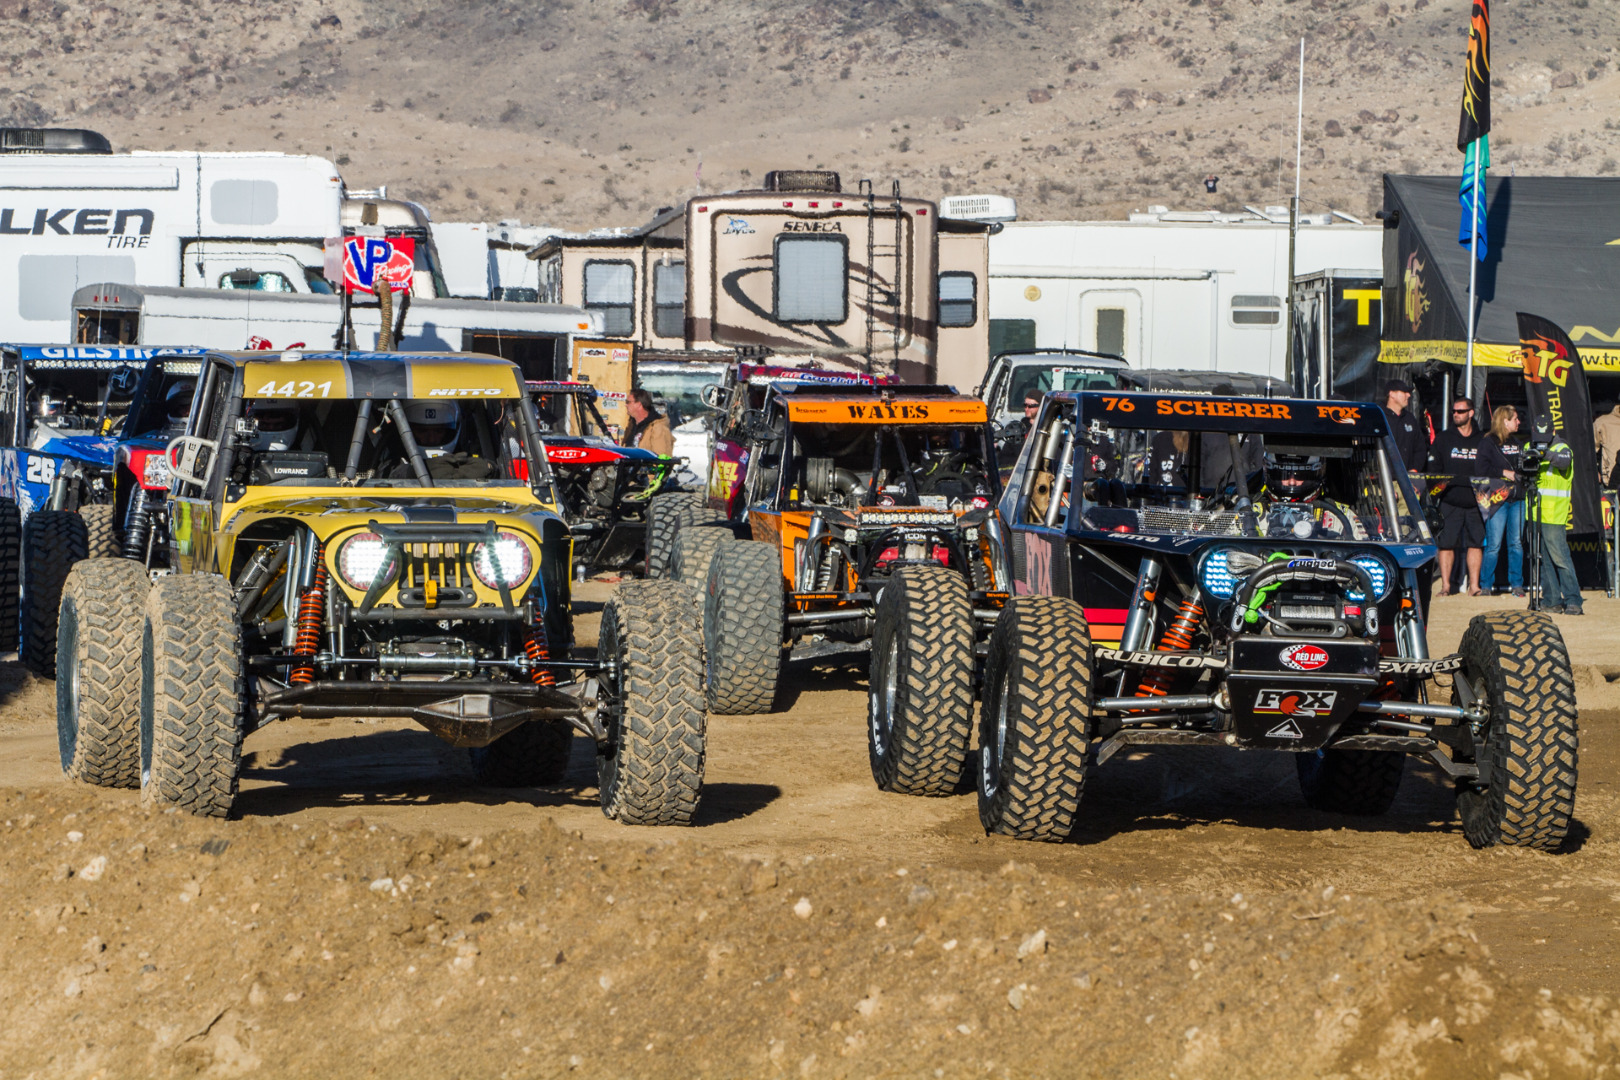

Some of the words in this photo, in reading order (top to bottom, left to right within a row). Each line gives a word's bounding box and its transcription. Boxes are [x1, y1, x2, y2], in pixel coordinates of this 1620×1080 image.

[783, 221, 842, 232] SENECA
[107, 236, 150, 248] TIRE
[345, 238, 393, 288] VP
[1535, 350, 1574, 387] TG
[258, 381, 332, 397] 4421
[429, 388, 500, 396] NITTO
[847, 405, 928, 418] WAYES
[1102, 397, 1135, 412] 76
[1156, 399, 1291, 419] SCHERER
[1317, 406, 1361, 423] FOX
[27, 455, 55, 484] 26
[274, 467, 308, 475] LOWRANCE
[1108, 533, 1160, 542] NITTO
[1294, 560, 1335, 569] rugged
[1094, 648, 1227, 668] RUBICON
[1295, 653, 1310, 661] RED
[1379, 657, 1463, 674] EXPRESS
[1258, 690, 1335, 716] FOX
